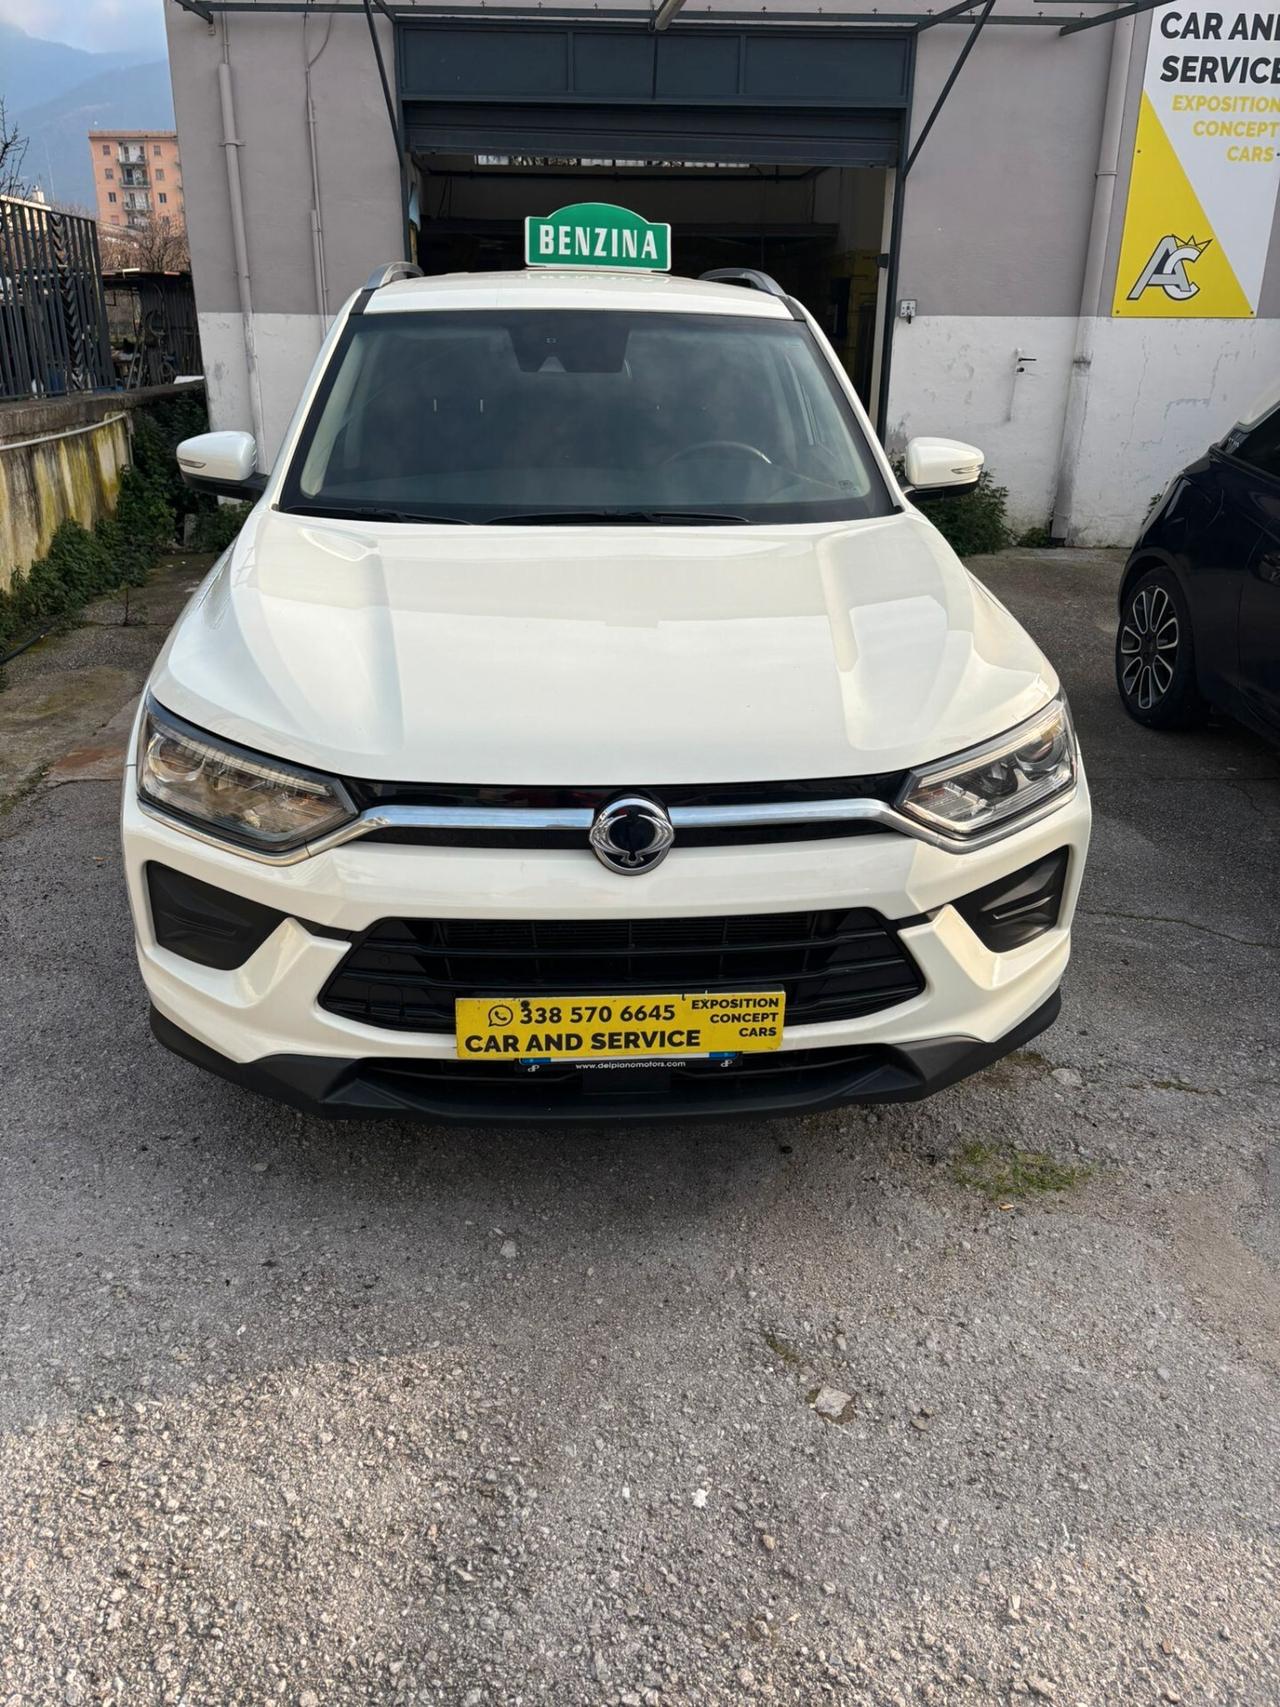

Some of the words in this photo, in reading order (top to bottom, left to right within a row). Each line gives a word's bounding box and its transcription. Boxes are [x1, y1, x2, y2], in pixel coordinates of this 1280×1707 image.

[1160, 11, 1223, 39] CAR
[1172, 95, 1280, 112] EXPOSITION
[1193, 120, 1280, 137] CONCEPT
[1226, 146, 1274, 162] CARS
[540, 225, 657, 259] BENZINA
[692, 998, 779, 1010] EXPOSITION
[520, 1006, 562, 1024] 338
[570, 1006, 612, 1023] 570
[620, 1005, 675, 1022] 6645
[710, 1012, 778, 1023] CONCEPT
[739, 1027, 777, 1037] CARS
[465, 1035, 520, 1053] CAR
[525, 1033, 583, 1052] AND
[591, 1029, 700, 1049] SERVICE
[575, 1061, 686, 1070] www.delpianomotors.com
